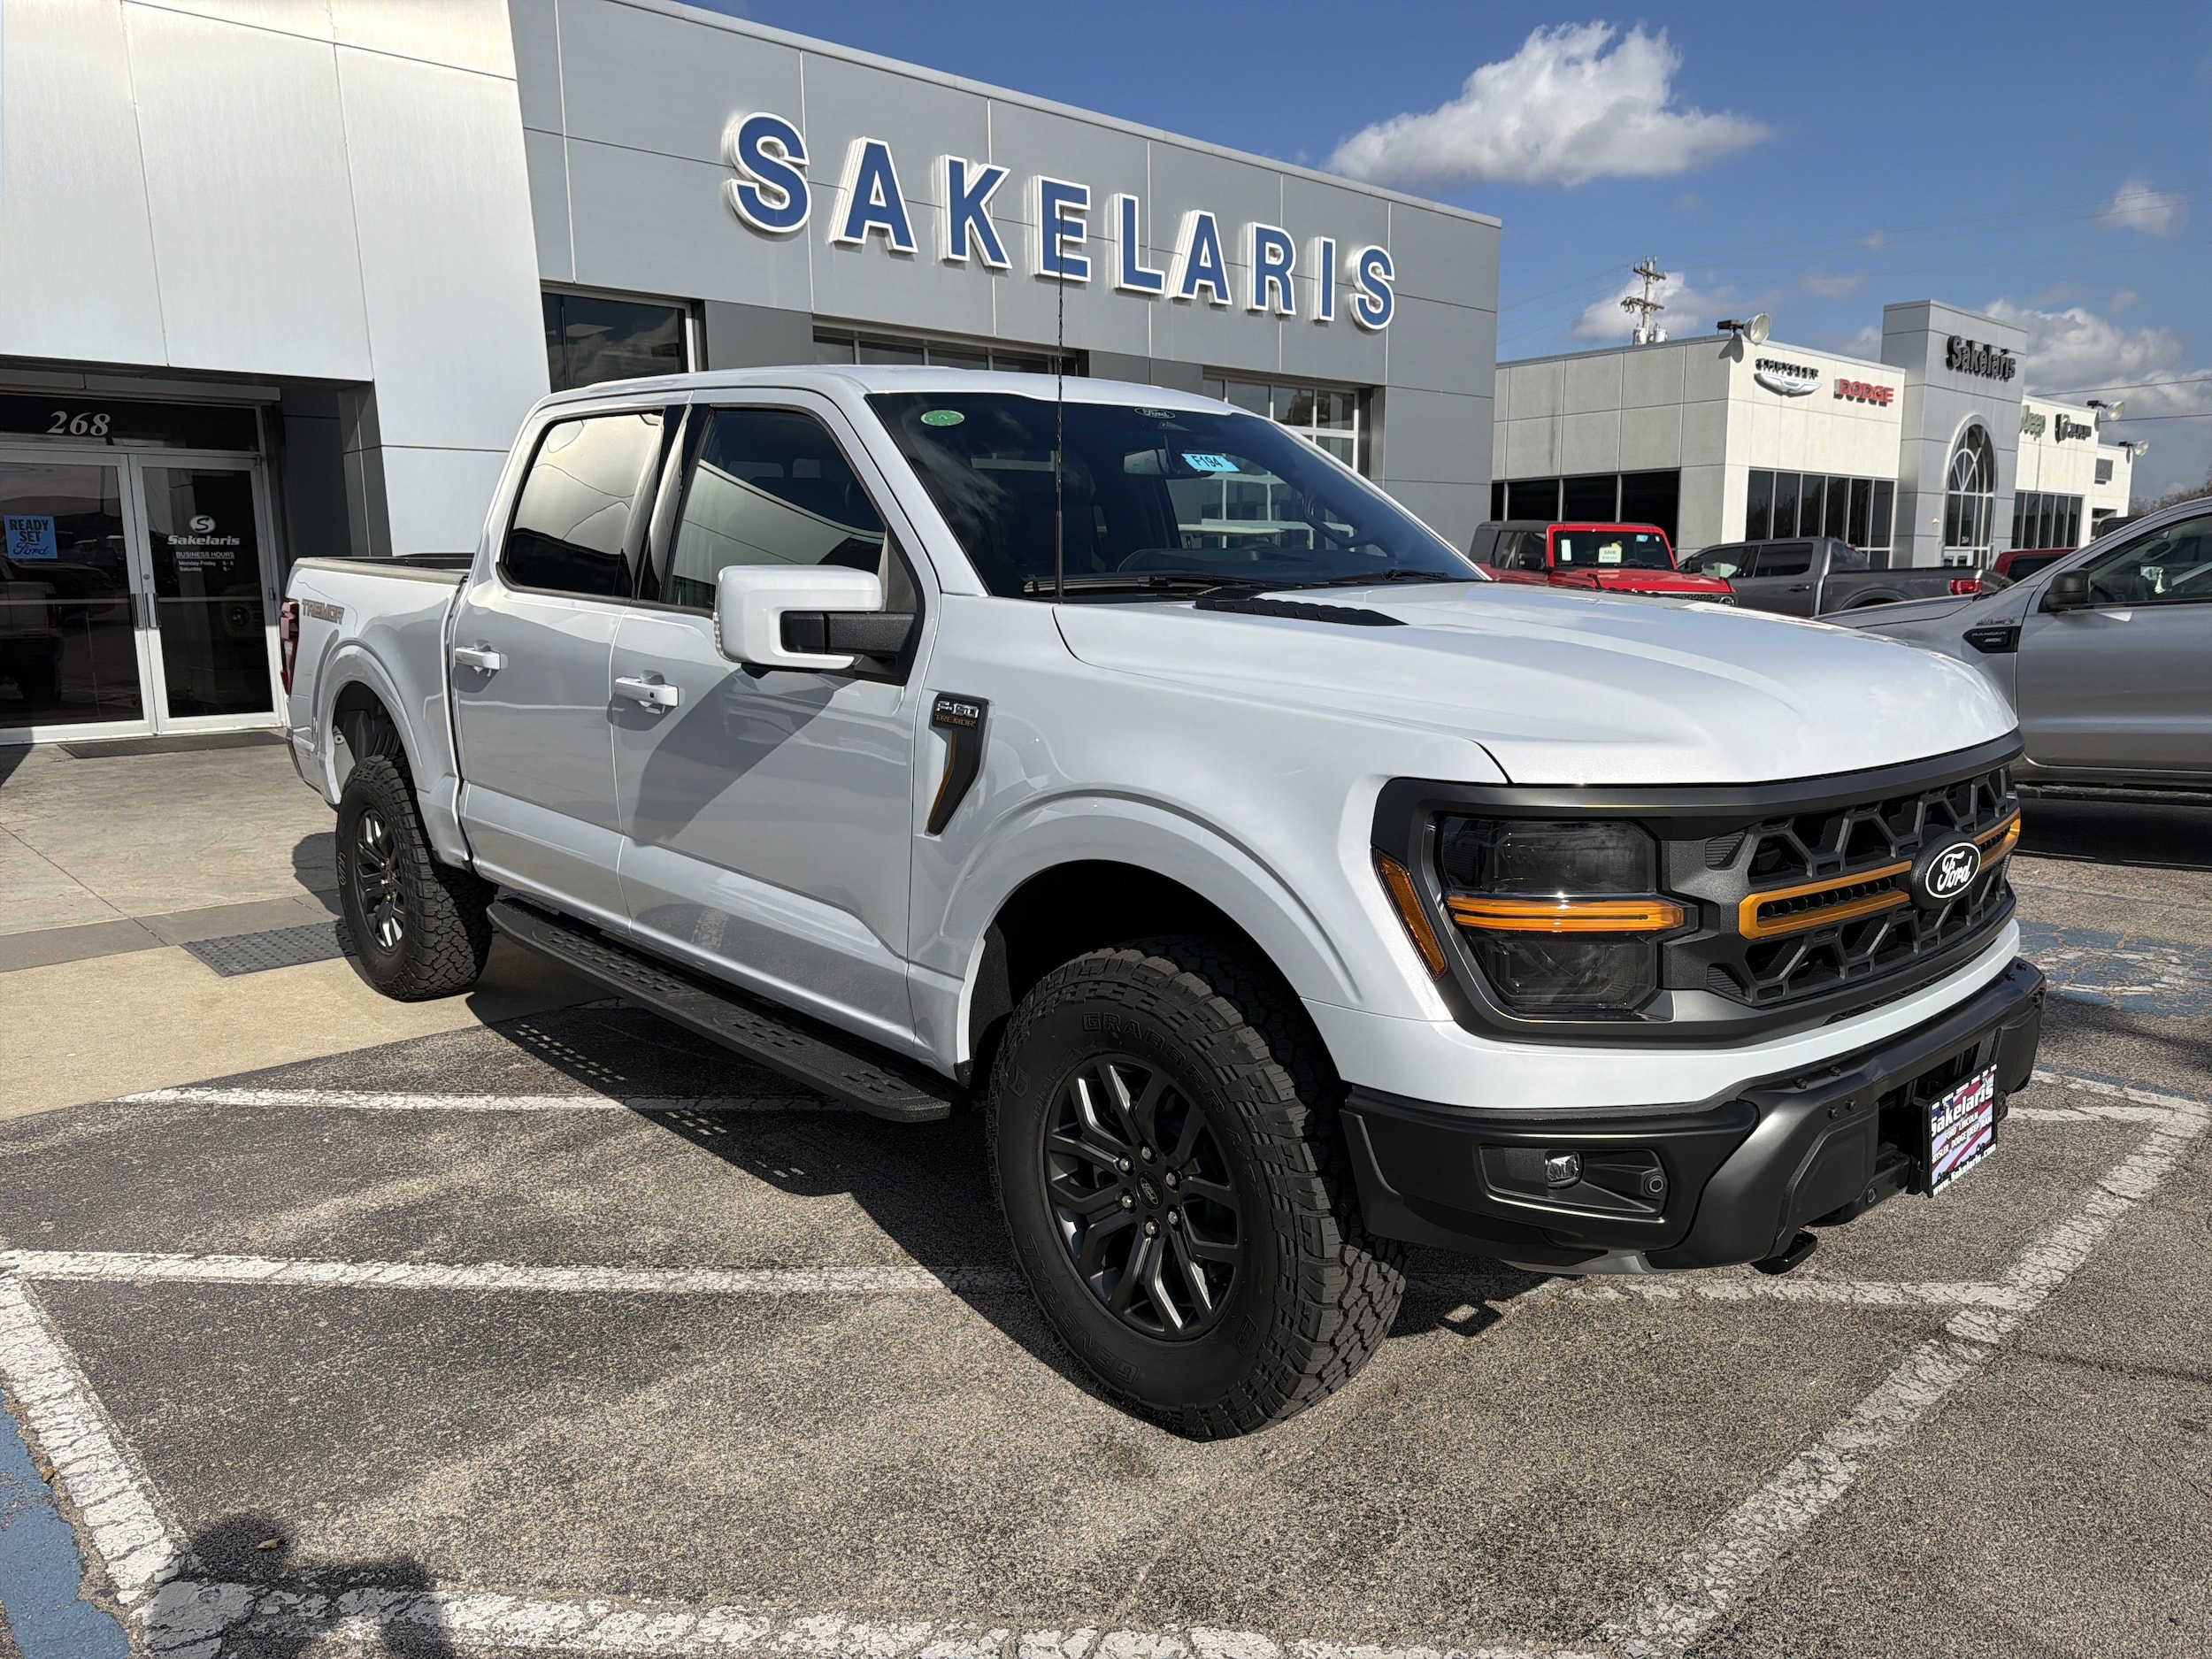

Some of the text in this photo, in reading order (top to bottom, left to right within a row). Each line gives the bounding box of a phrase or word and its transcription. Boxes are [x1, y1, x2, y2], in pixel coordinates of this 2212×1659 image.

[726, 111, 1396, 333] SAKELARIS
[1947, 334, 2016, 380] Sakelaris
[1838, 378, 1894, 404] DODGE
[46, 411, 111, 436] 268
[1142, 408, 1171, 419] Ford
[2022, 404, 2047, 437] Jeep
[1191, 455, 1224, 468] F194
[9, 518, 49, 532] READY
[19, 531, 42, 542] SET
[167, 534, 241, 546] Sakelaris
[12, 541, 50, 556] Ford
[302, 598, 344, 625] TREMOR
[935, 700, 979, 718] F-150
[934, 713, 977, 728] TREMOR
[1937, 850, 1972, 892] Ford
[1081, 1011, 1225, 1114] GRABBER
[1932, 1082, 1993, 1138] Sakelaris
[1958, 1110, 1978, 1132] LINCOLN
[1951, 1132, 1967, 1148] DODGE
